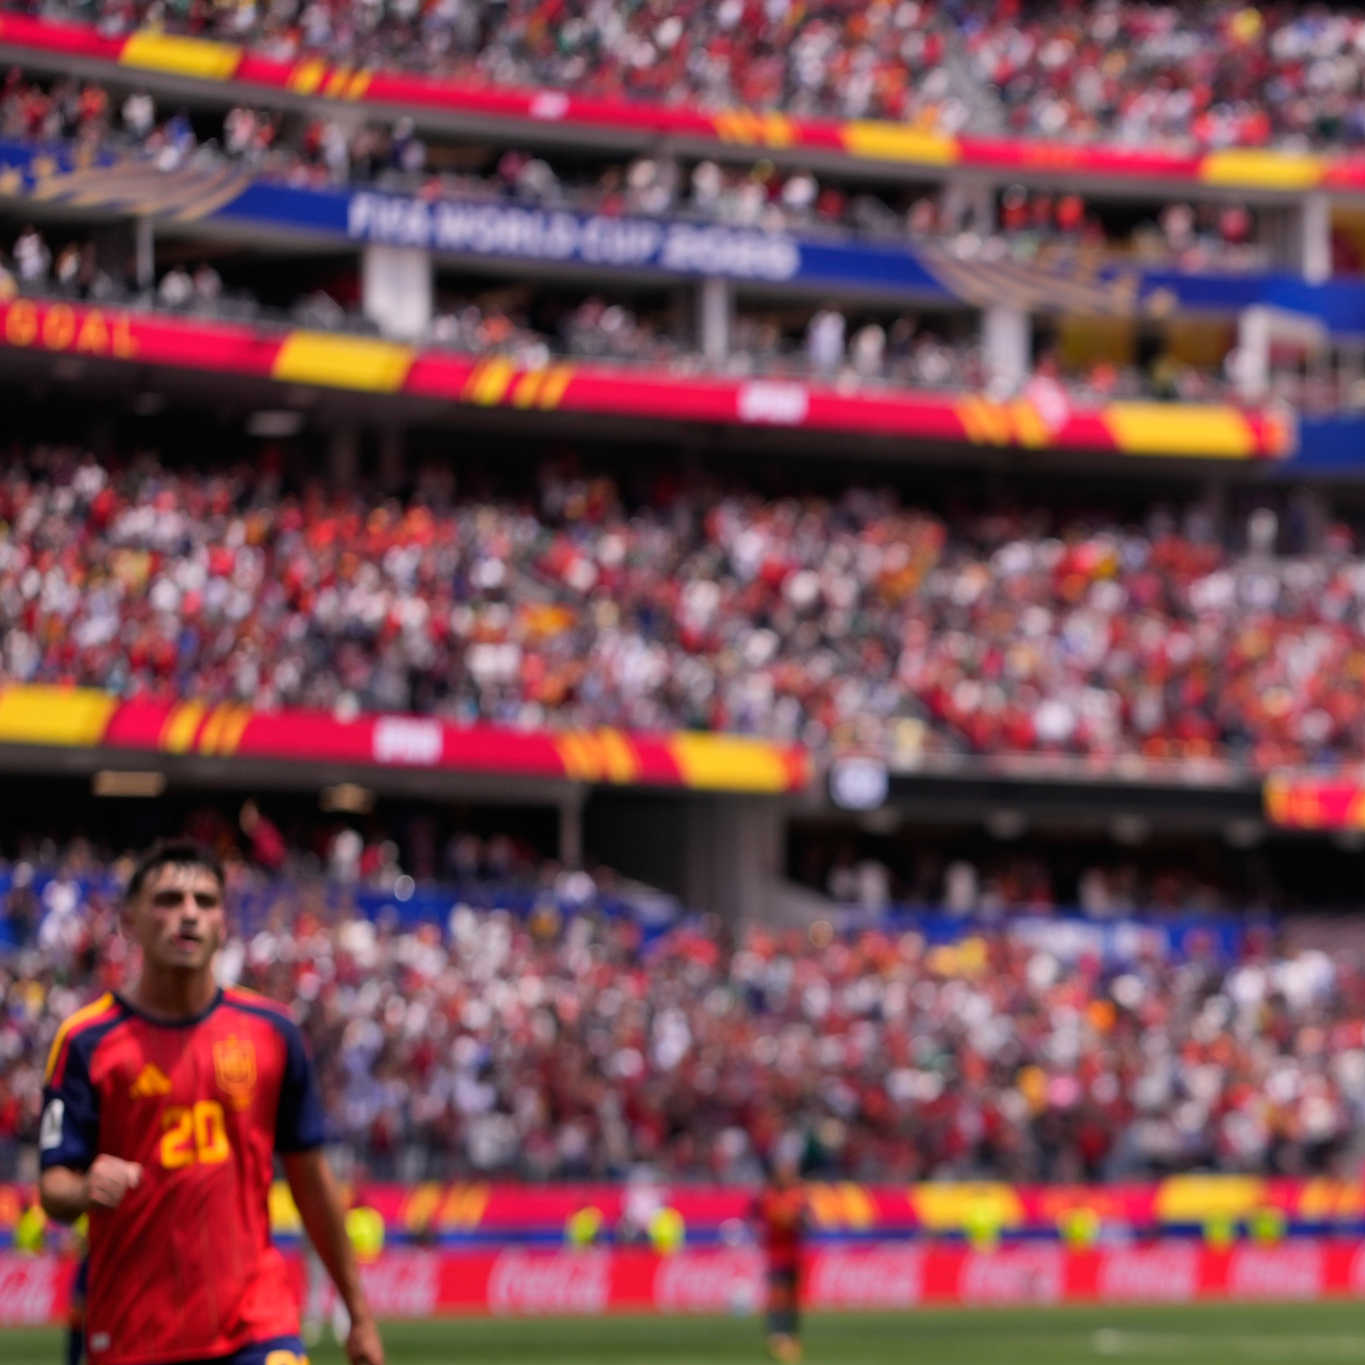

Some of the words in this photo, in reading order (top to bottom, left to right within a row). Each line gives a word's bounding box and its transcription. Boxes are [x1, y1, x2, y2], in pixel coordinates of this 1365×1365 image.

[434, 202, 580, 260] WORLD
[4, 299, 141, 359] GOAL
[160, 1100, 230, 1169] 20
